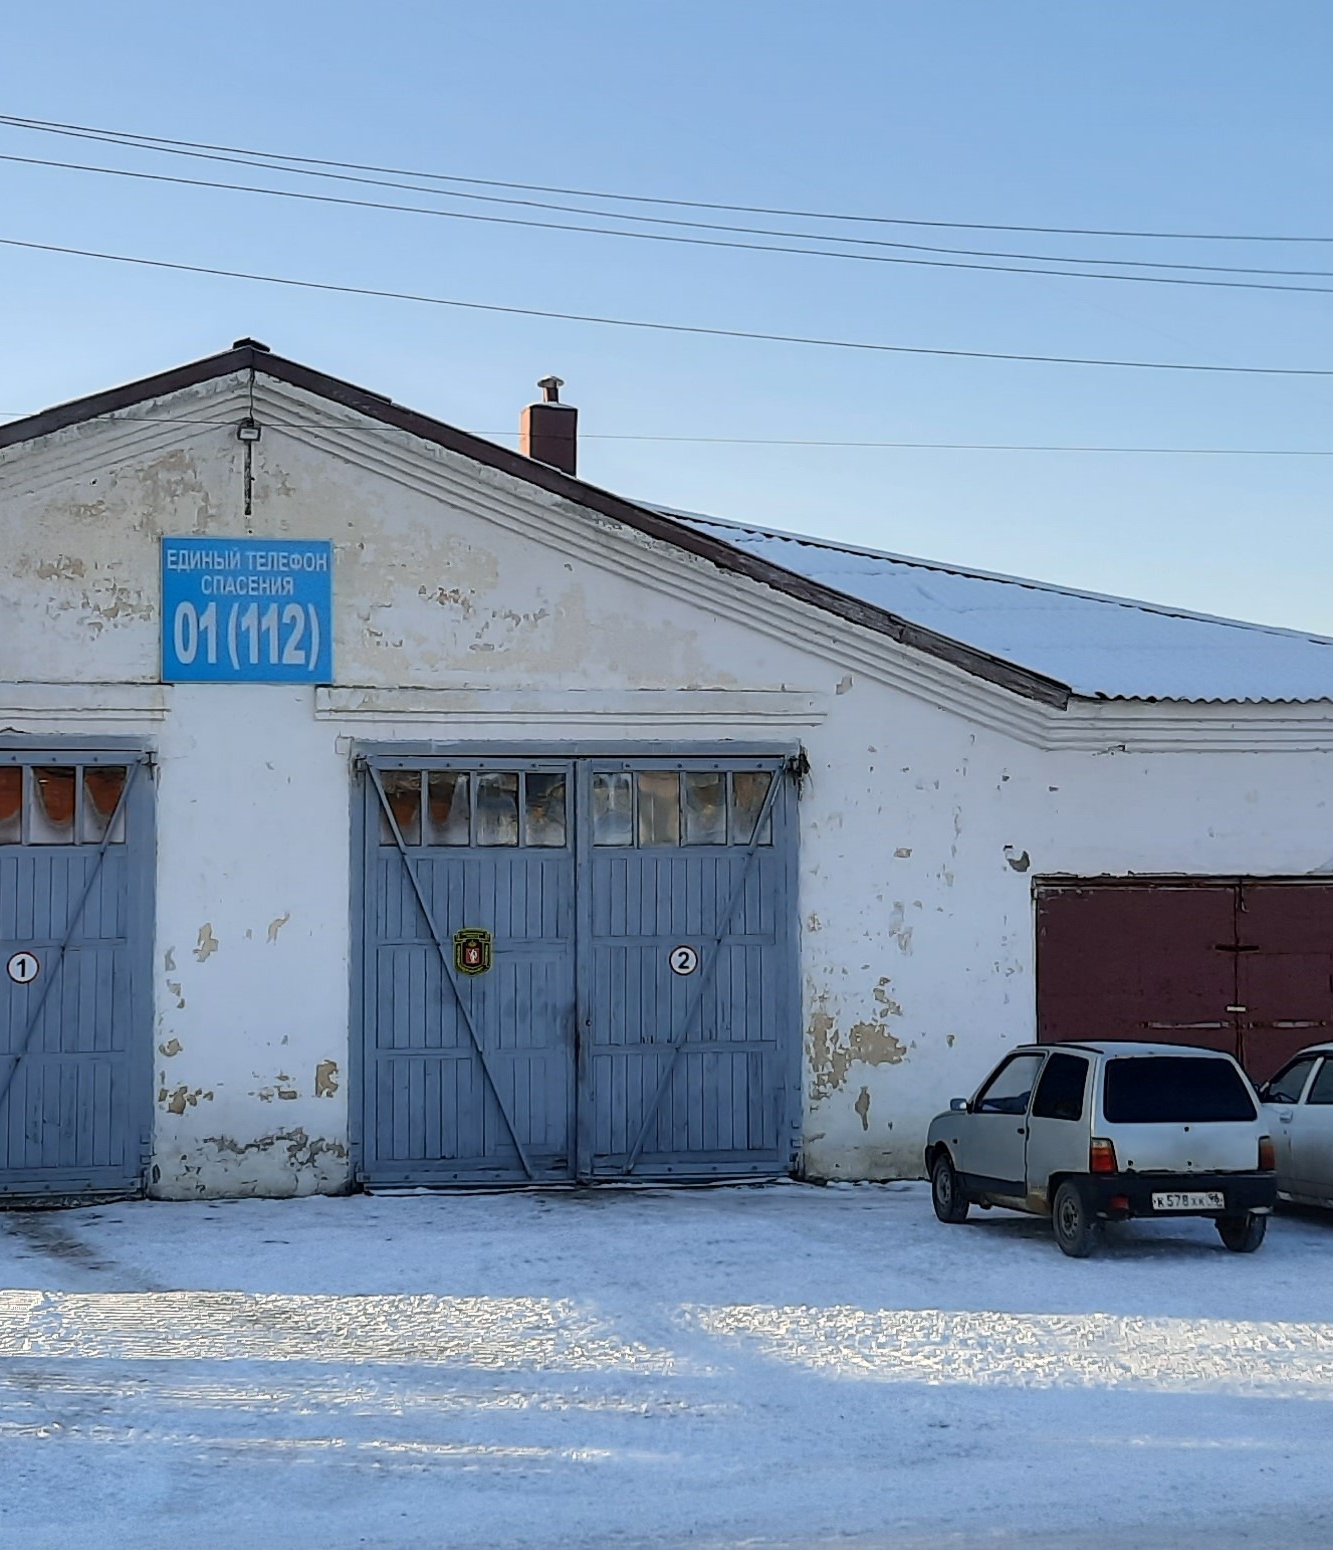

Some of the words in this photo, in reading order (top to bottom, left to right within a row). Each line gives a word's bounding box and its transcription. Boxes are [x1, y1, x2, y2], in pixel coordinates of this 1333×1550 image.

[167, 547, 241, 573] ЕДИНЫЙ
[245, 551, 328, 572] ТЕЛЕФОН
[201, 574, 294, 596] СПАСЕНИЯ
[16, 958, 26, 977] 1
[677, 951, 690, 969] 2
